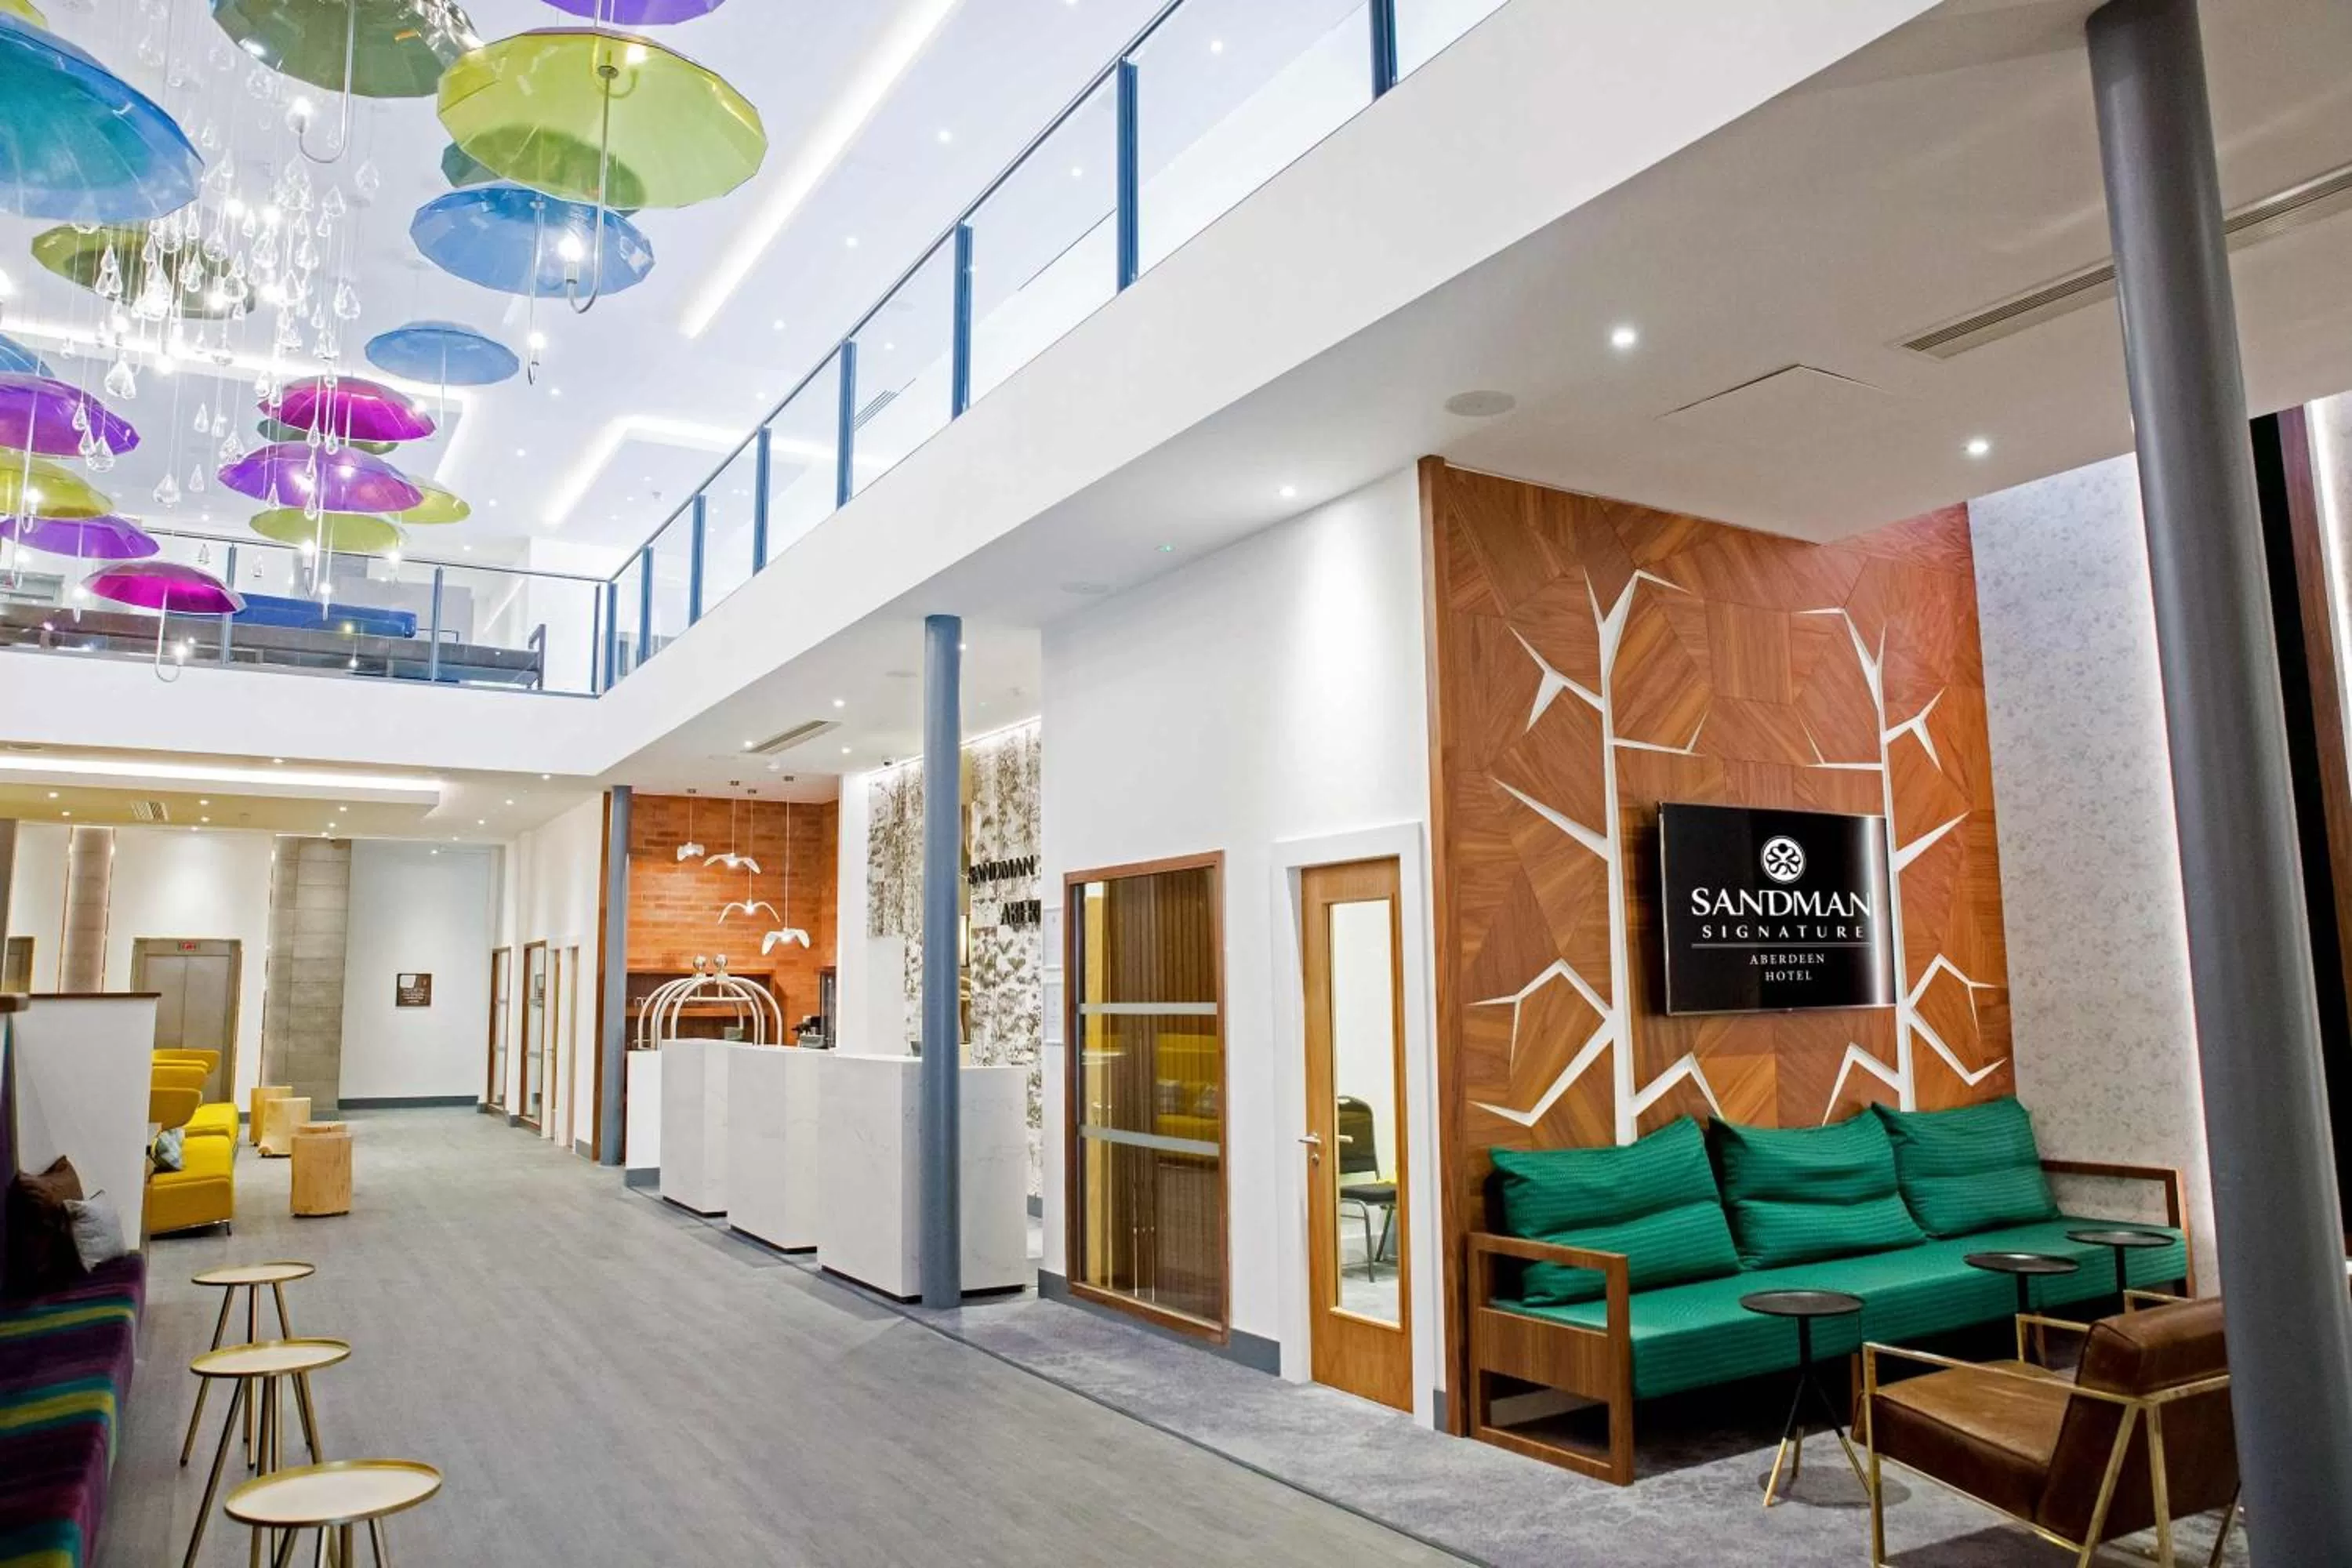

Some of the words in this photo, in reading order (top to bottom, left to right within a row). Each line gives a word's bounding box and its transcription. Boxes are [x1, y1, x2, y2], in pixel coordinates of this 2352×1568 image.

[1690, 888, 1871, 916] SANDMAN
[1701, 925, 1864, 938] SIGNATURE
[1749, 953, 1825, 965] ABERDEEN
[1765, 971, 1813, 981] HOTEL
